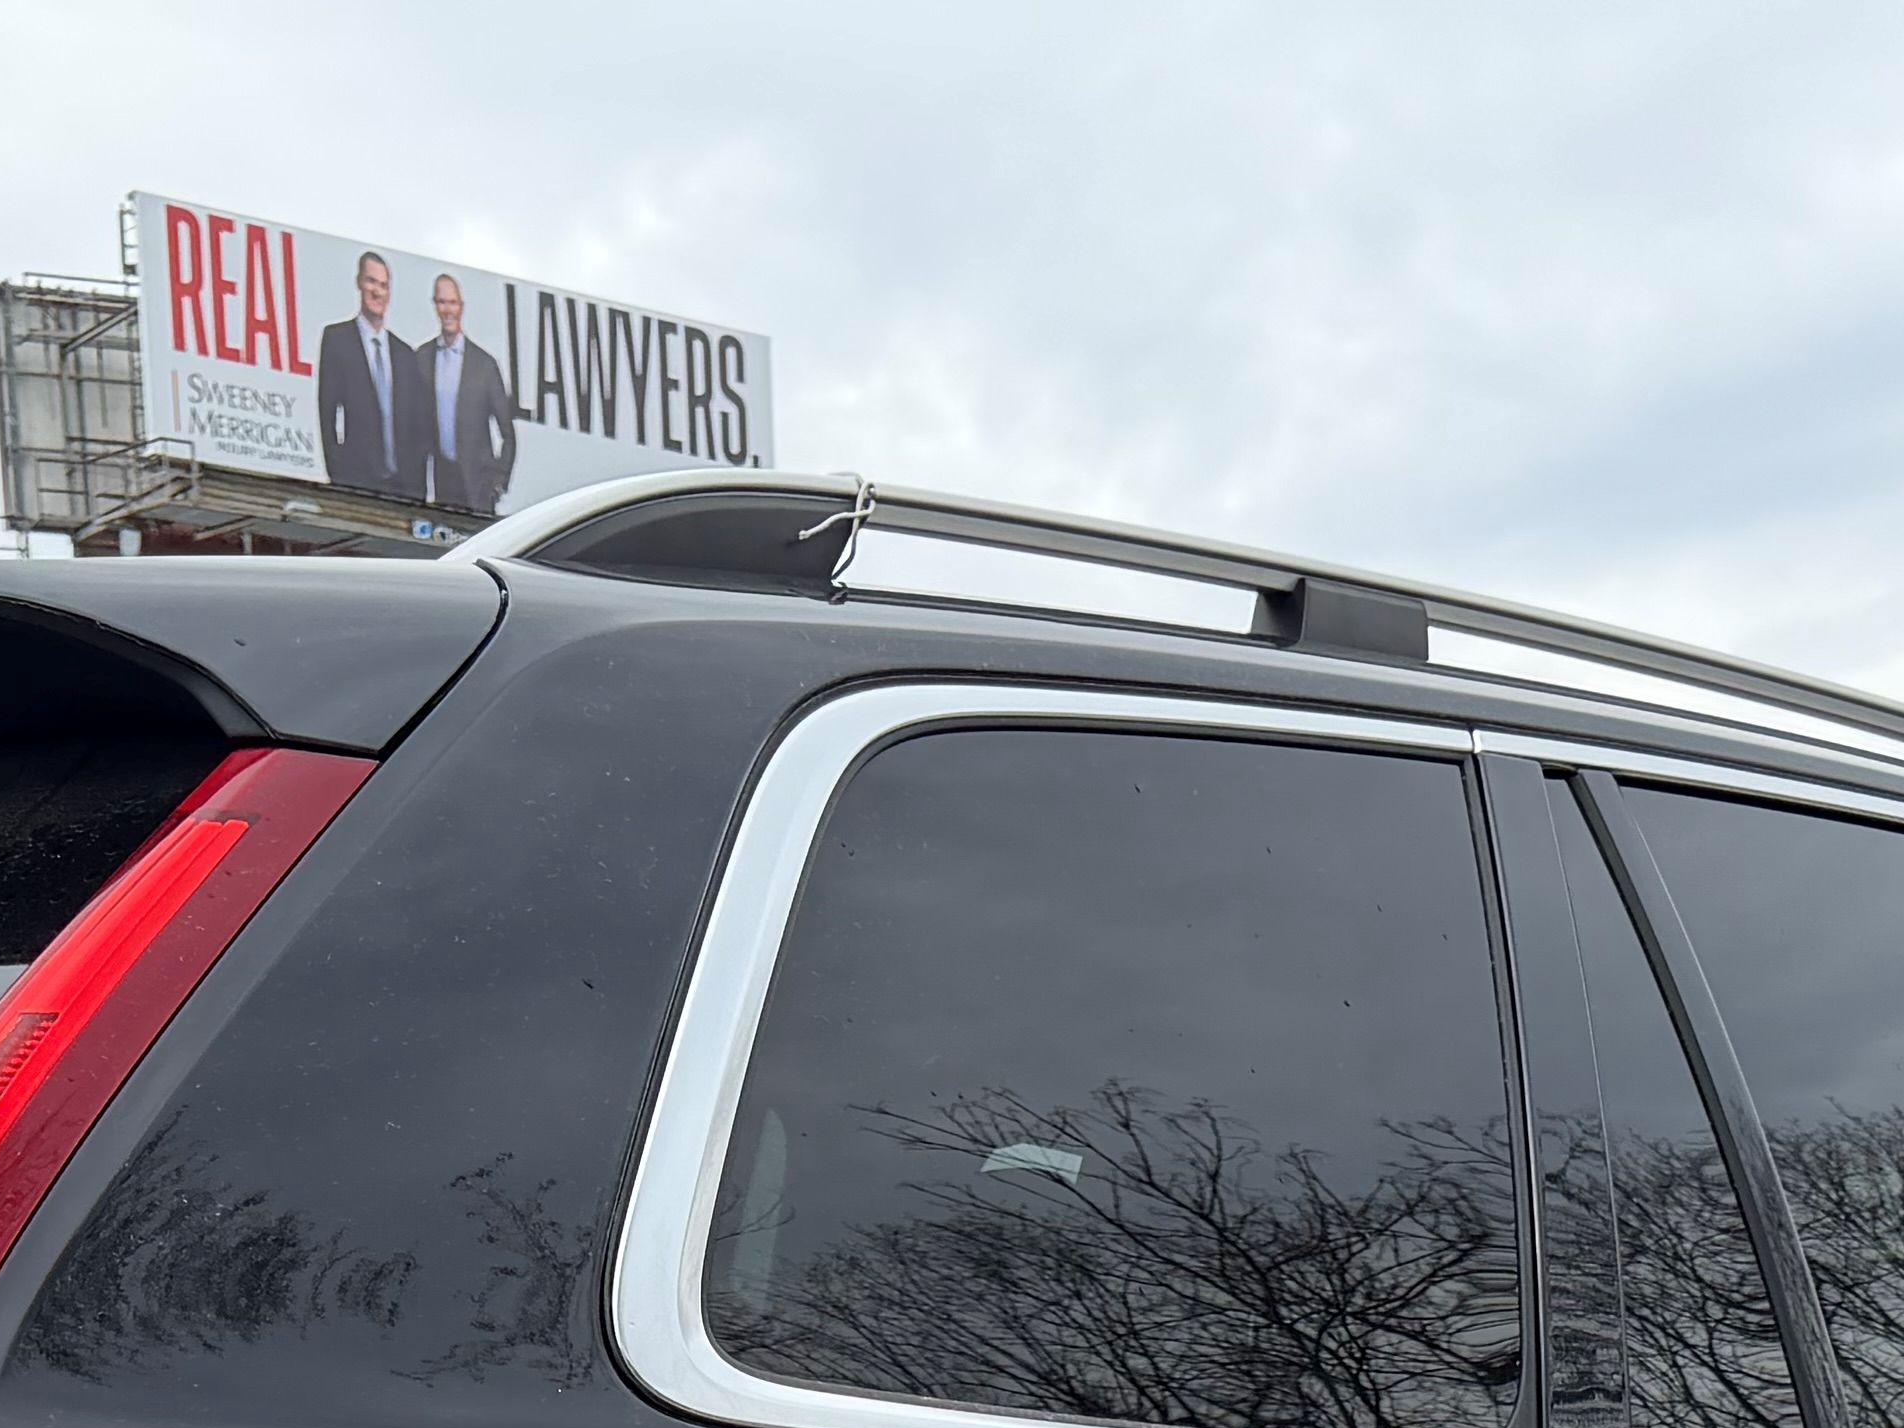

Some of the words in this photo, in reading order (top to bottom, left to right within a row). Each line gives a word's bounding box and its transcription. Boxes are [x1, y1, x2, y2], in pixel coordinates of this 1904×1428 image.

[166, 204, 312, 377] REAL
[505, 283, 760, 468] LAWYERS.
[187, 372, 297, 418] SWEENEY
[188, 406, 314, 453] MERRIGAN
